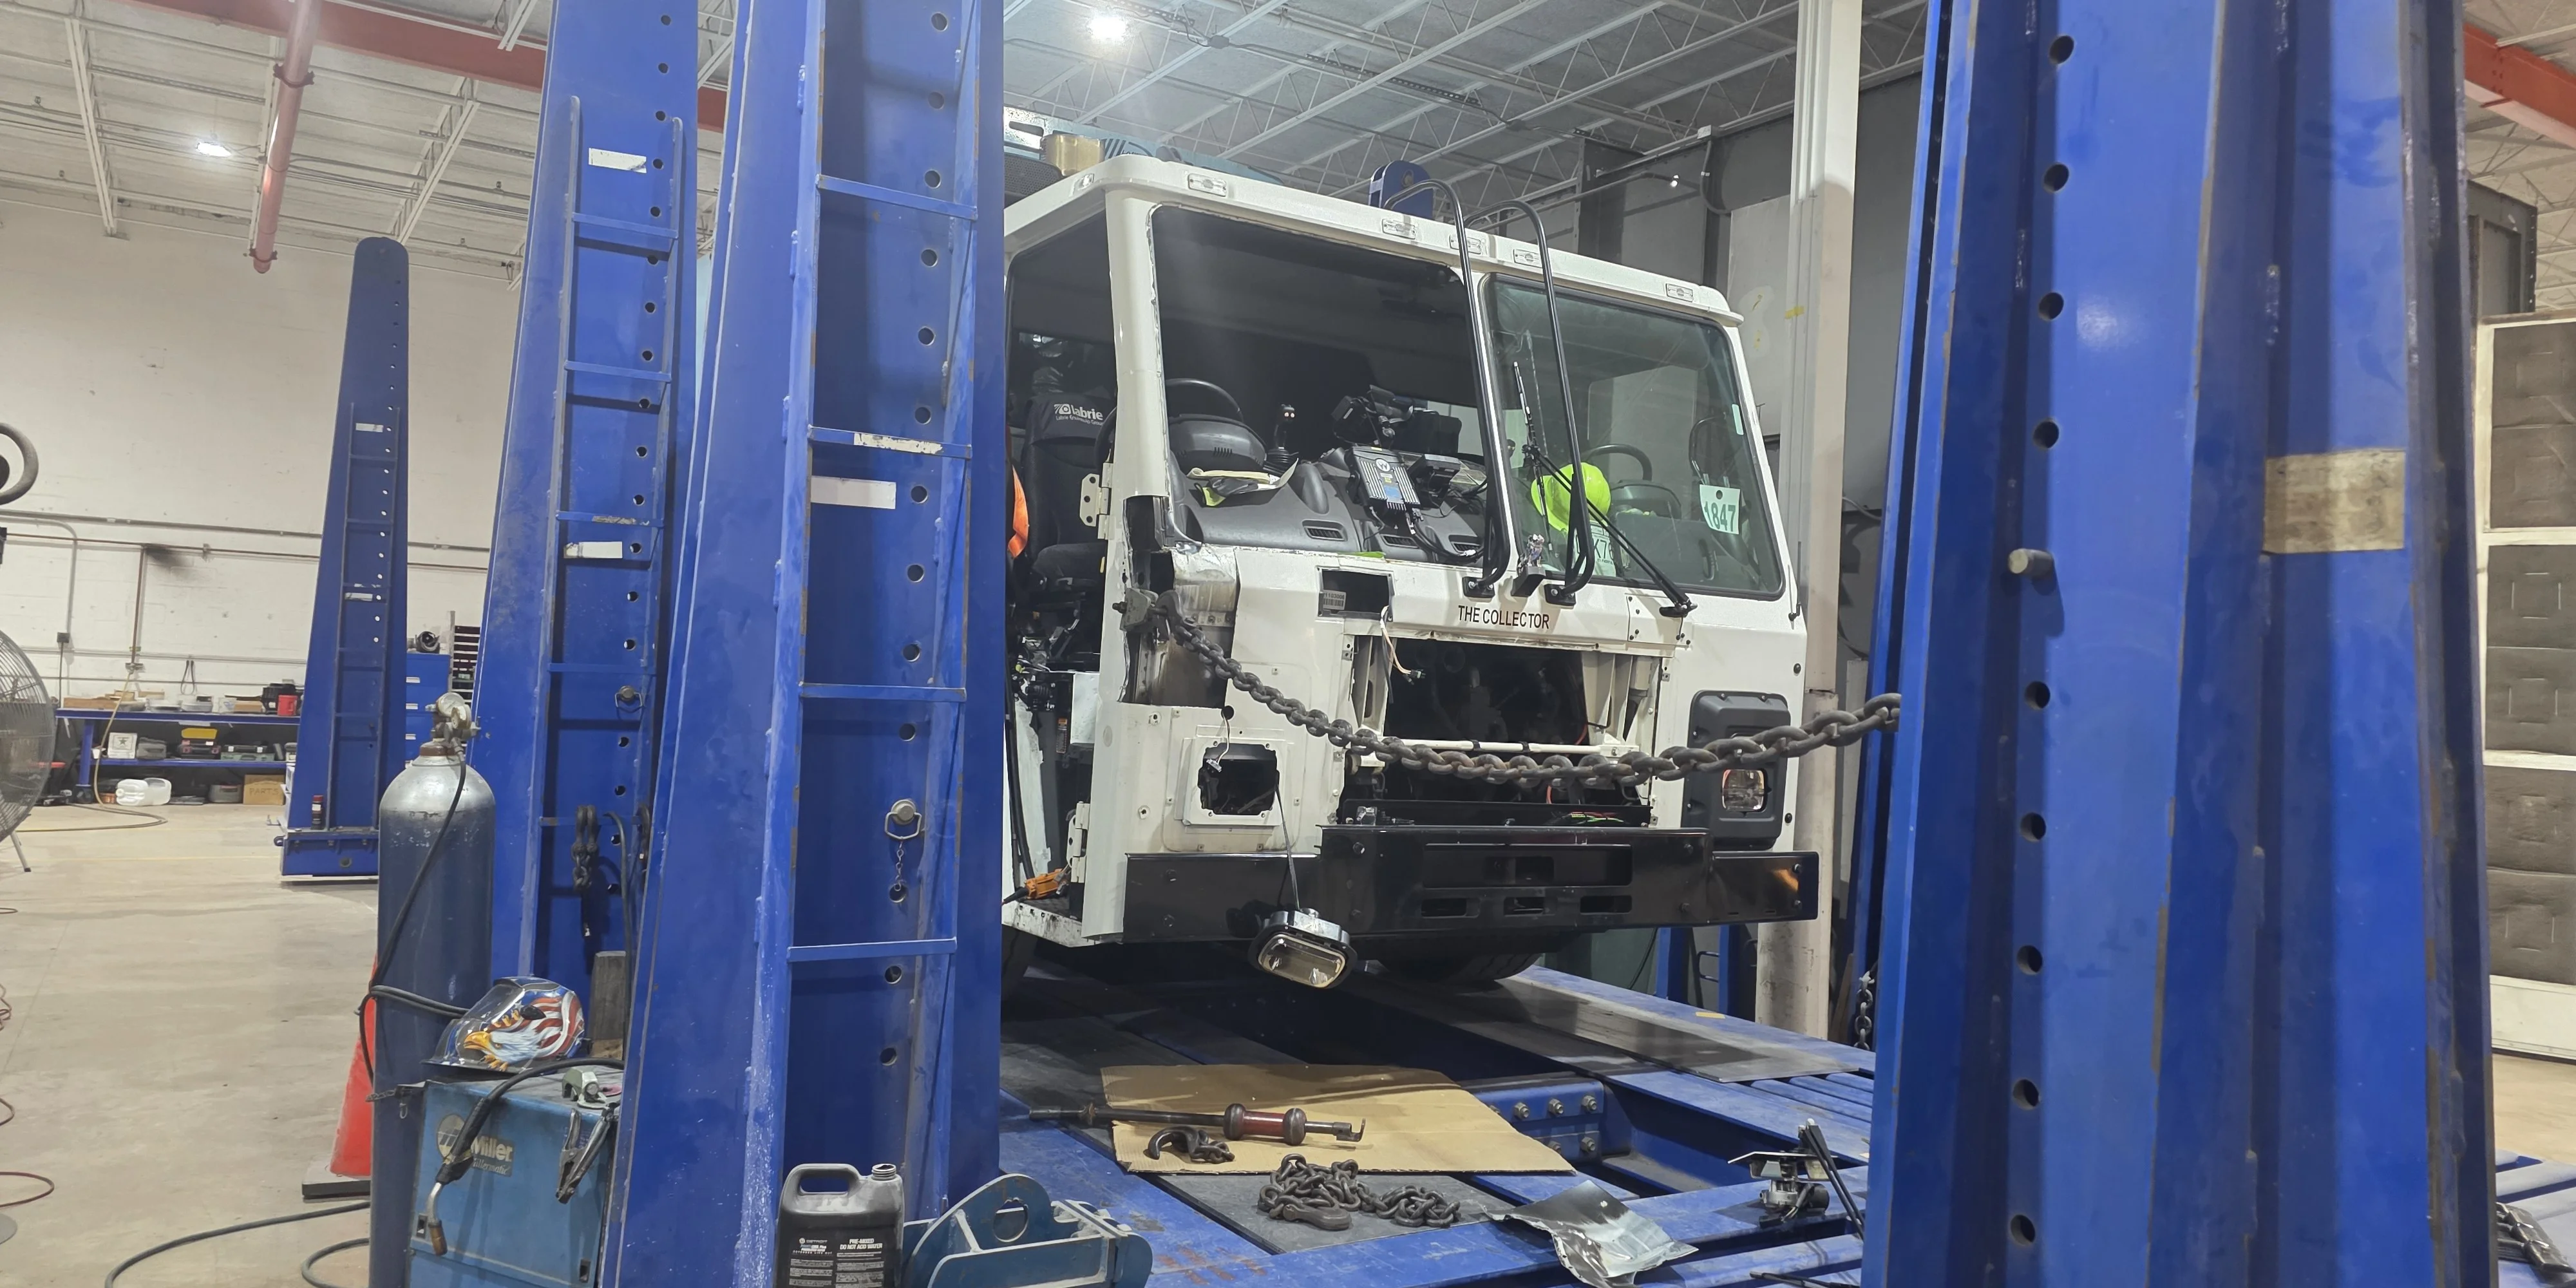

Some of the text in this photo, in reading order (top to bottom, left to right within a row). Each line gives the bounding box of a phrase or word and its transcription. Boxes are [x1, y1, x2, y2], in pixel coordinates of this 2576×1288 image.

[1704, 501, 1736, 532] 1847
[1458, 605, 1549, 629] THE COLLECTOR
[249, 788, 279, 796] PARTS
[472, 1158, 511, 1175] illermatic
